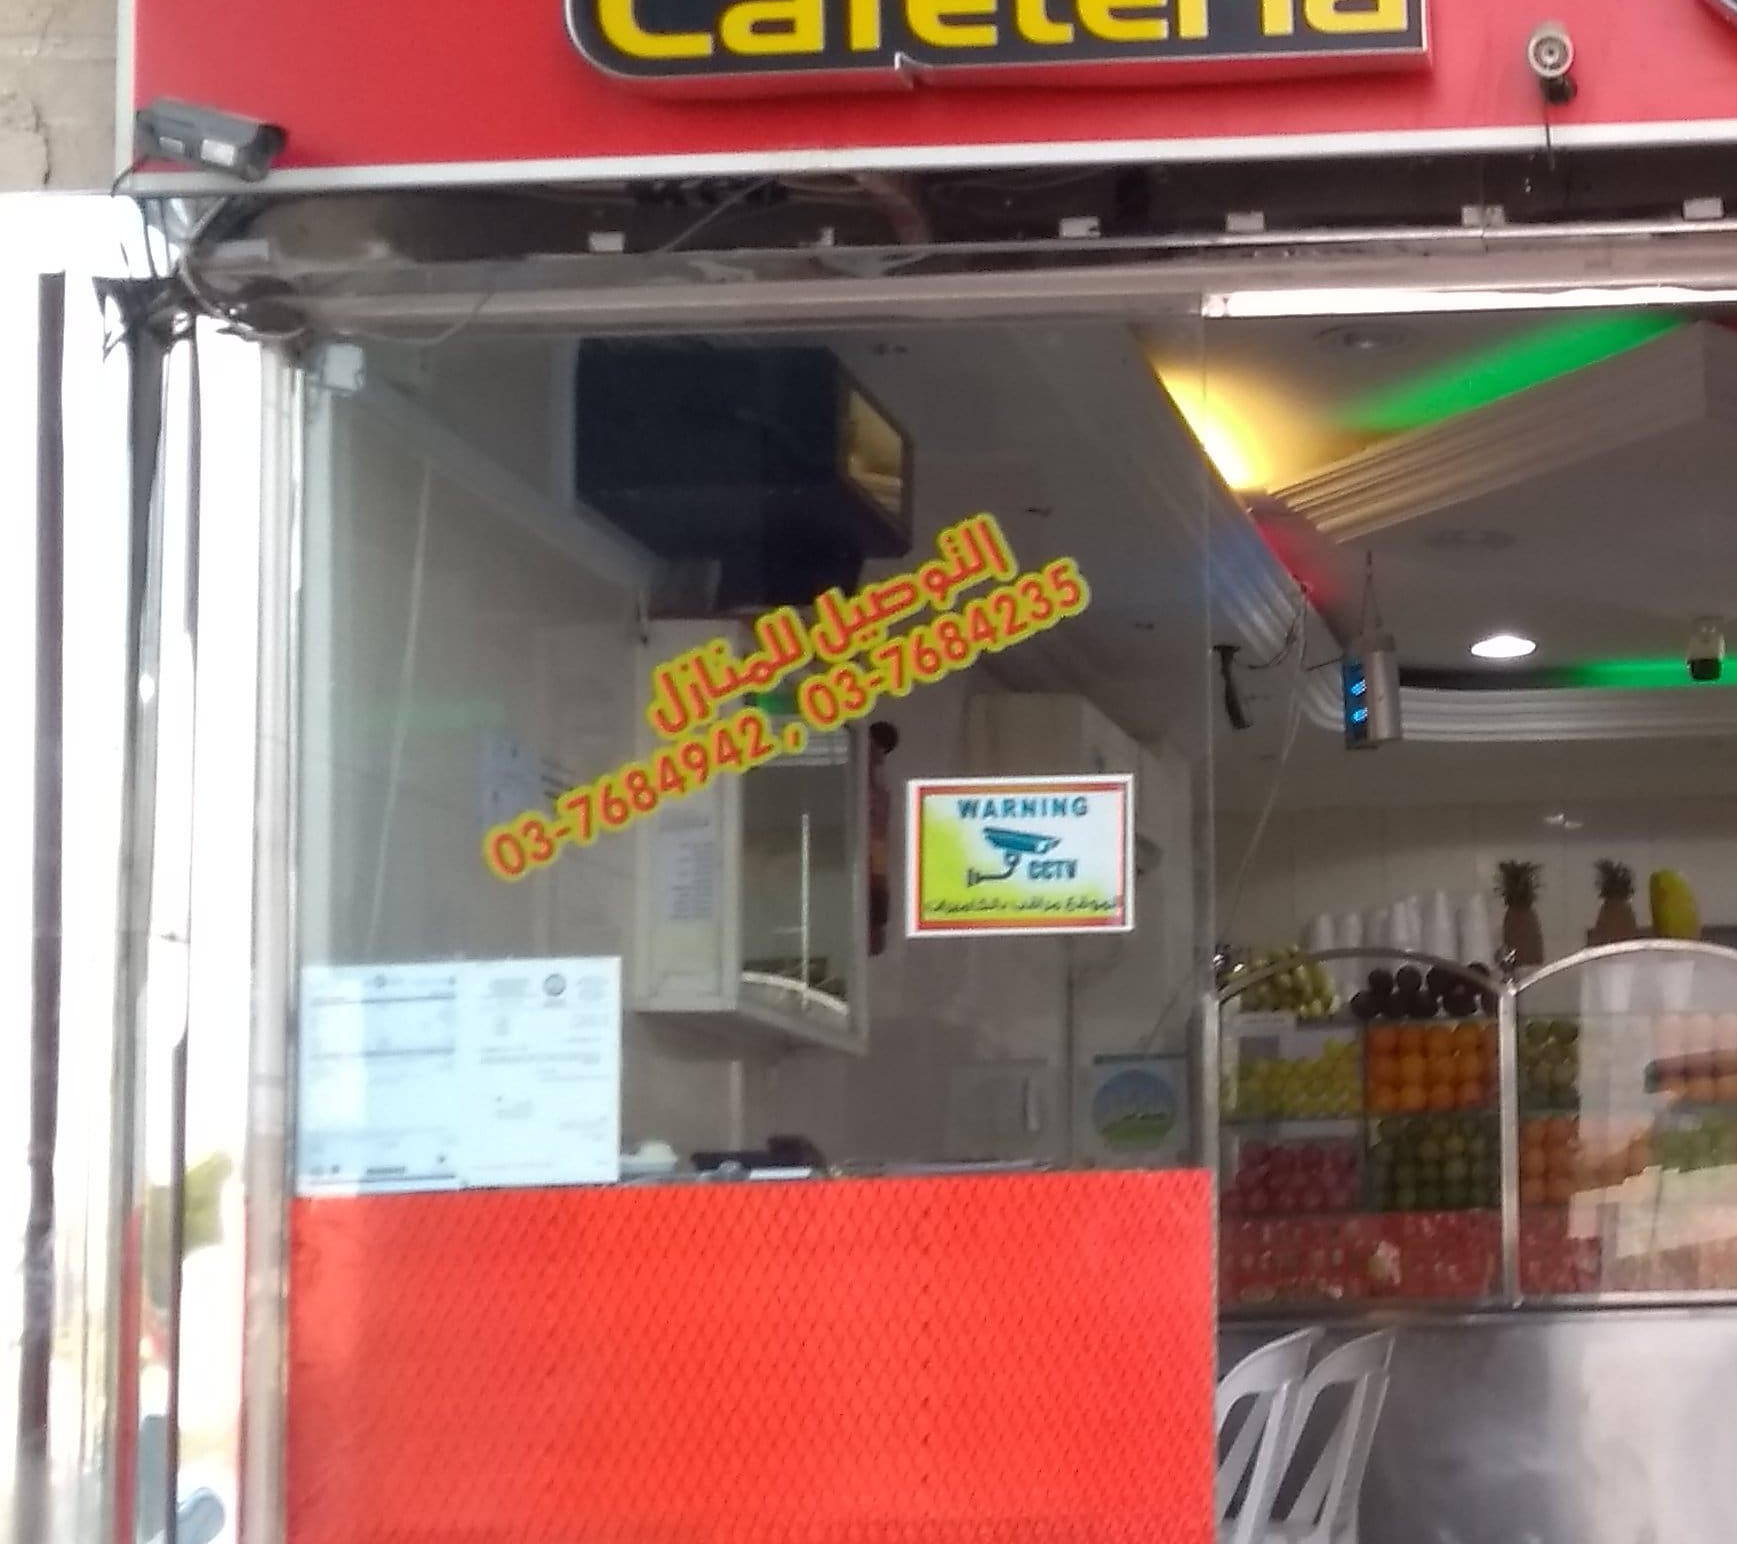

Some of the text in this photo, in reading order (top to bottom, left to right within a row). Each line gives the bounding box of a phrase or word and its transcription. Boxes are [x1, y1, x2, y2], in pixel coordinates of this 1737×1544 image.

[651, 518, 1010, 734] التوصيل للمنازل
[489, 713, 776, 876] 03-7684942
[801, 561, 1082, 726] 03-7684235
[957, 796, 1089, 819] WARNING
[1027, 858, 1078, 880] CCTV
